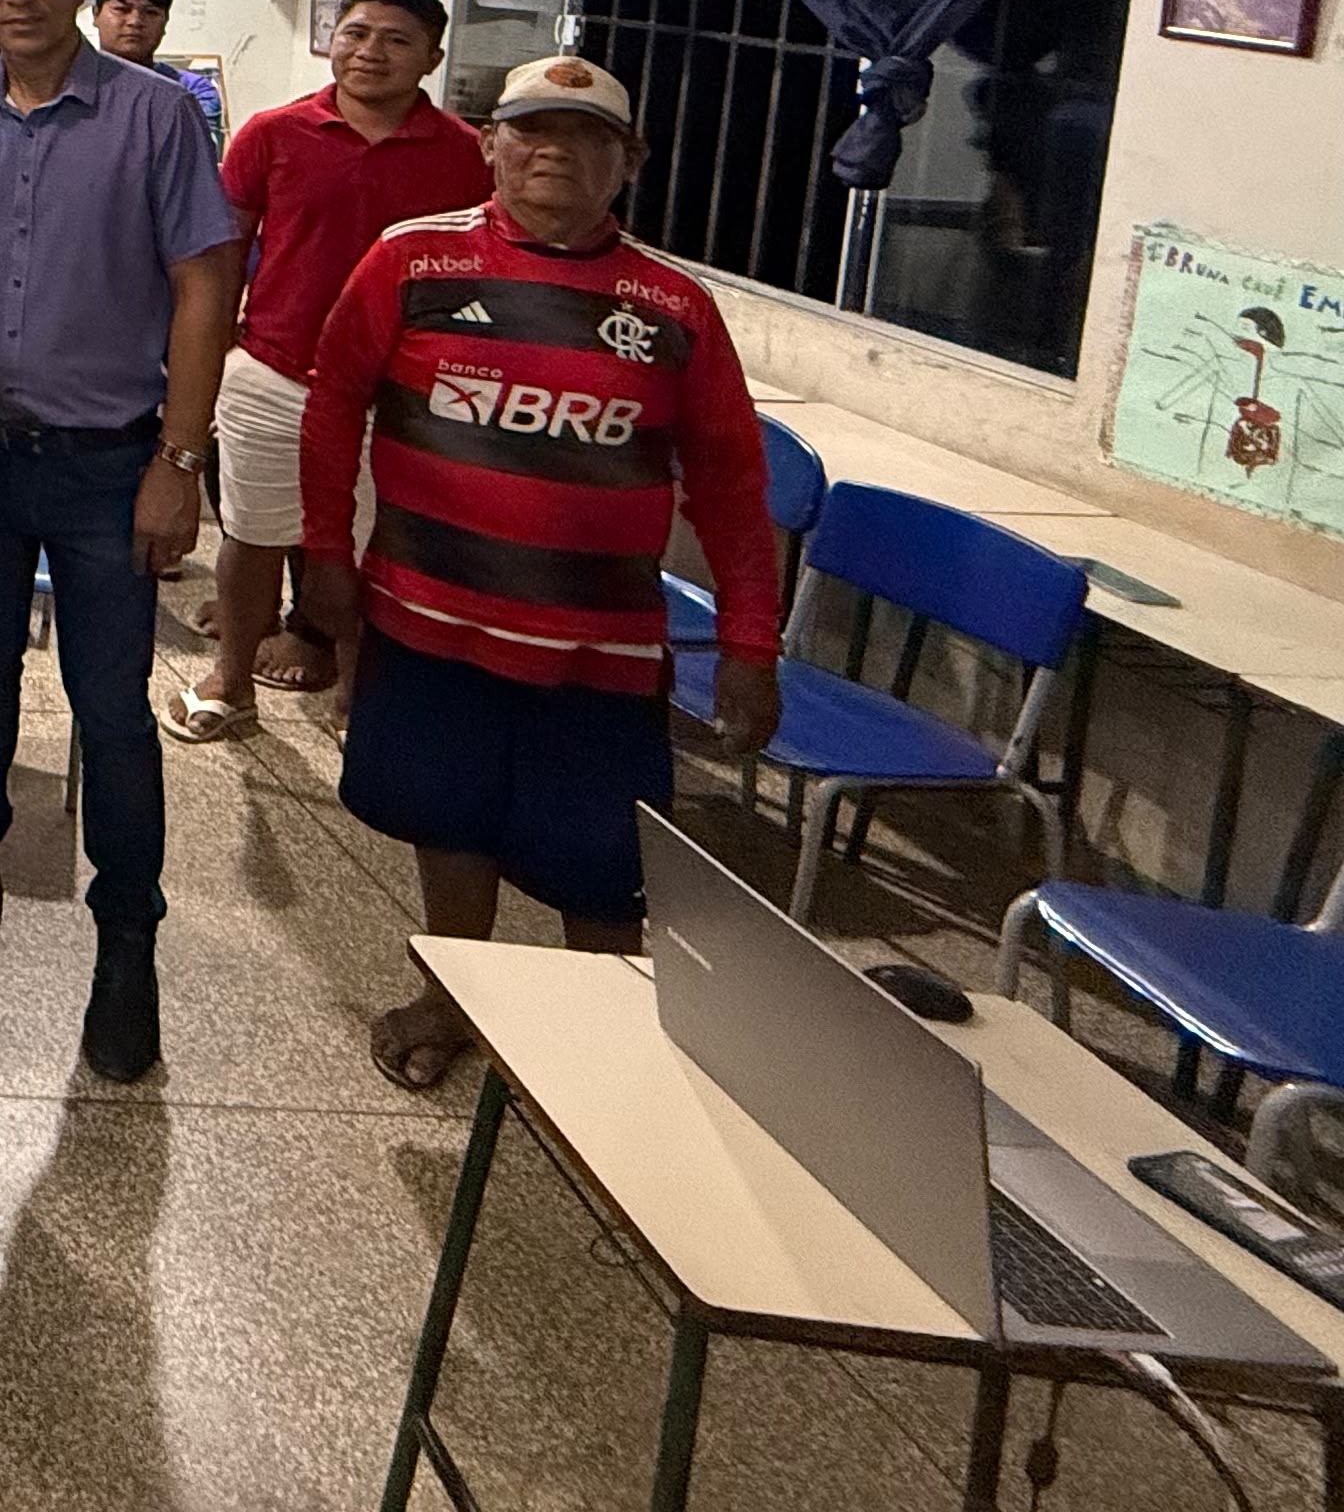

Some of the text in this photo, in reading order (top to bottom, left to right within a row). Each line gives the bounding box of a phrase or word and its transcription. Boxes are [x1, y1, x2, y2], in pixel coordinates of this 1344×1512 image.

[410, 254, 483, 278] pixbet
[438, 358, 503, 378] banco
[498, 384, 643, 446] BRB
